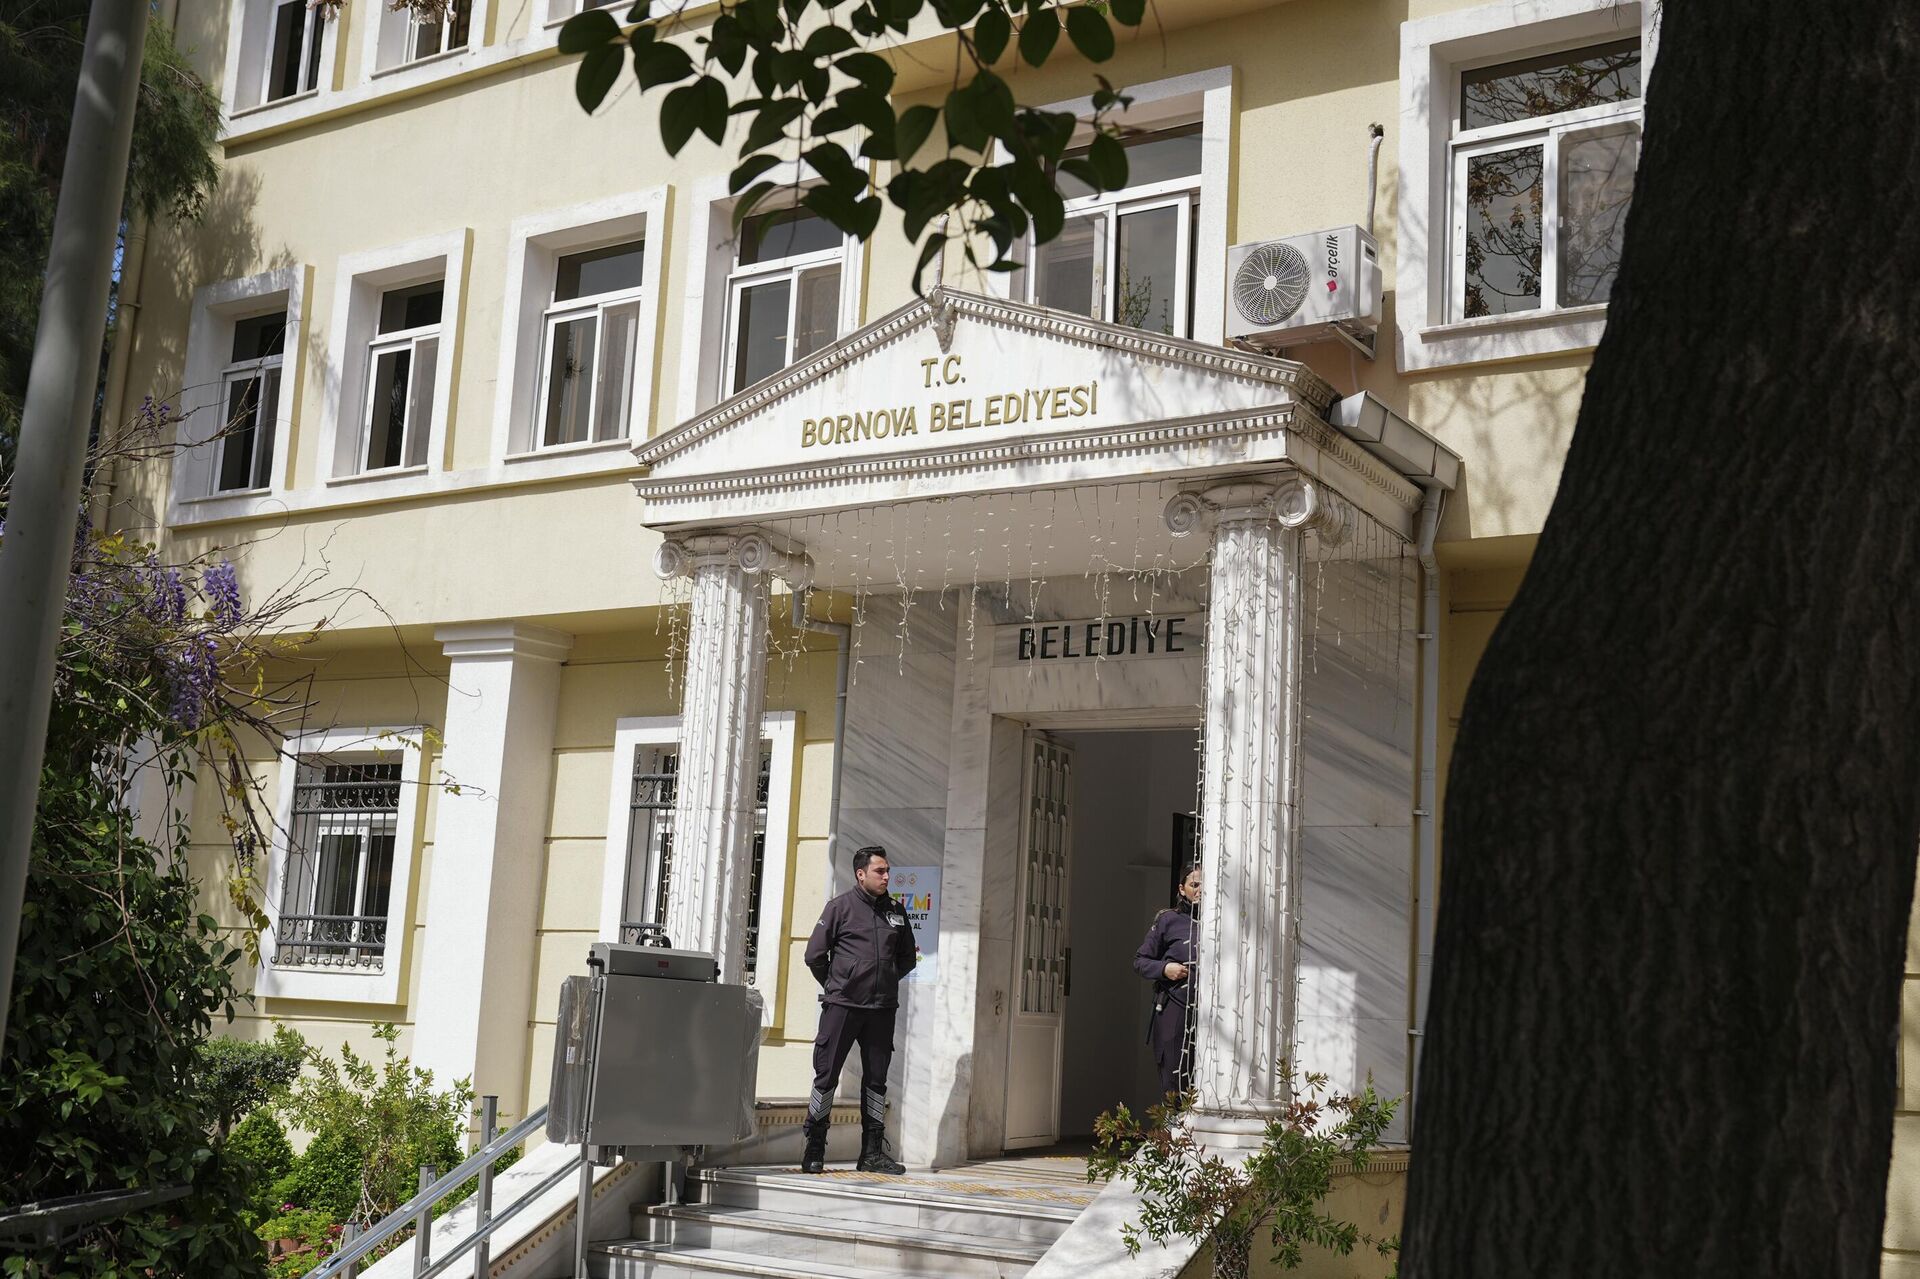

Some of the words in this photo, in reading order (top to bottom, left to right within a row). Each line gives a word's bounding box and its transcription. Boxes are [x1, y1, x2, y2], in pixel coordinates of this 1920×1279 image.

[1326, 234, 1340, 278] arçelik
[920, 354, 966, 388] T.C.
[801, 406, 918, 447] BORNOVA
[929, 381, 1098, 432] BELEDİYESİ
[1018, 617, 1186, 660] BELEDİYE
